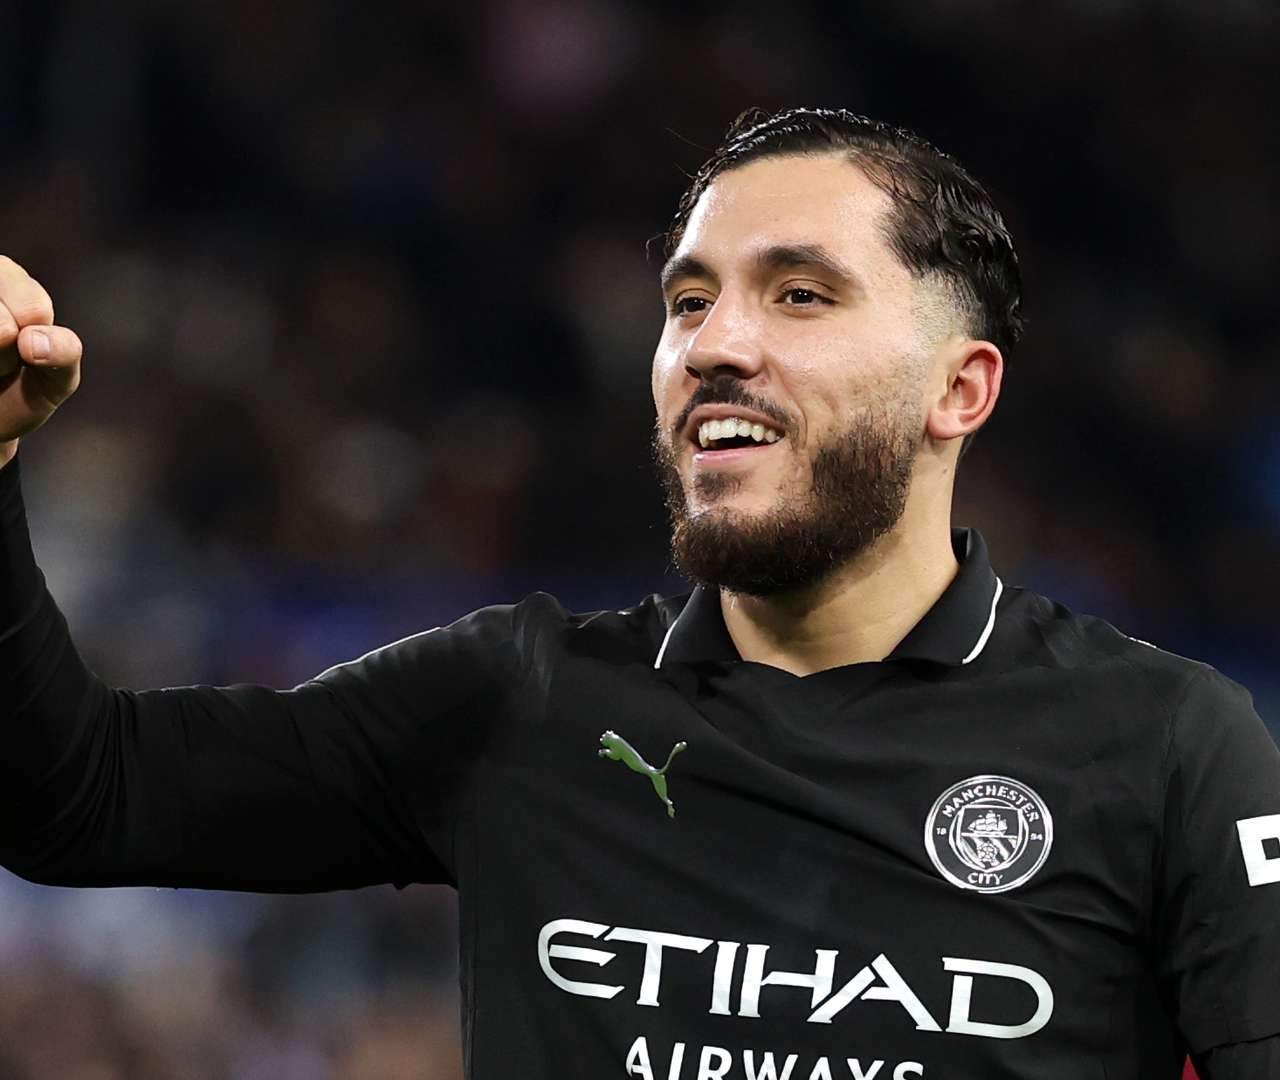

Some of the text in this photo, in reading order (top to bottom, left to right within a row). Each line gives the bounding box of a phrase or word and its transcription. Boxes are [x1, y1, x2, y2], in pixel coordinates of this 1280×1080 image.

[942, 785, 1040, 823] MANCHESTER
[968, 872, 1003, 885] CITY
[537, 917, 1055, 1040] ETIHAD
